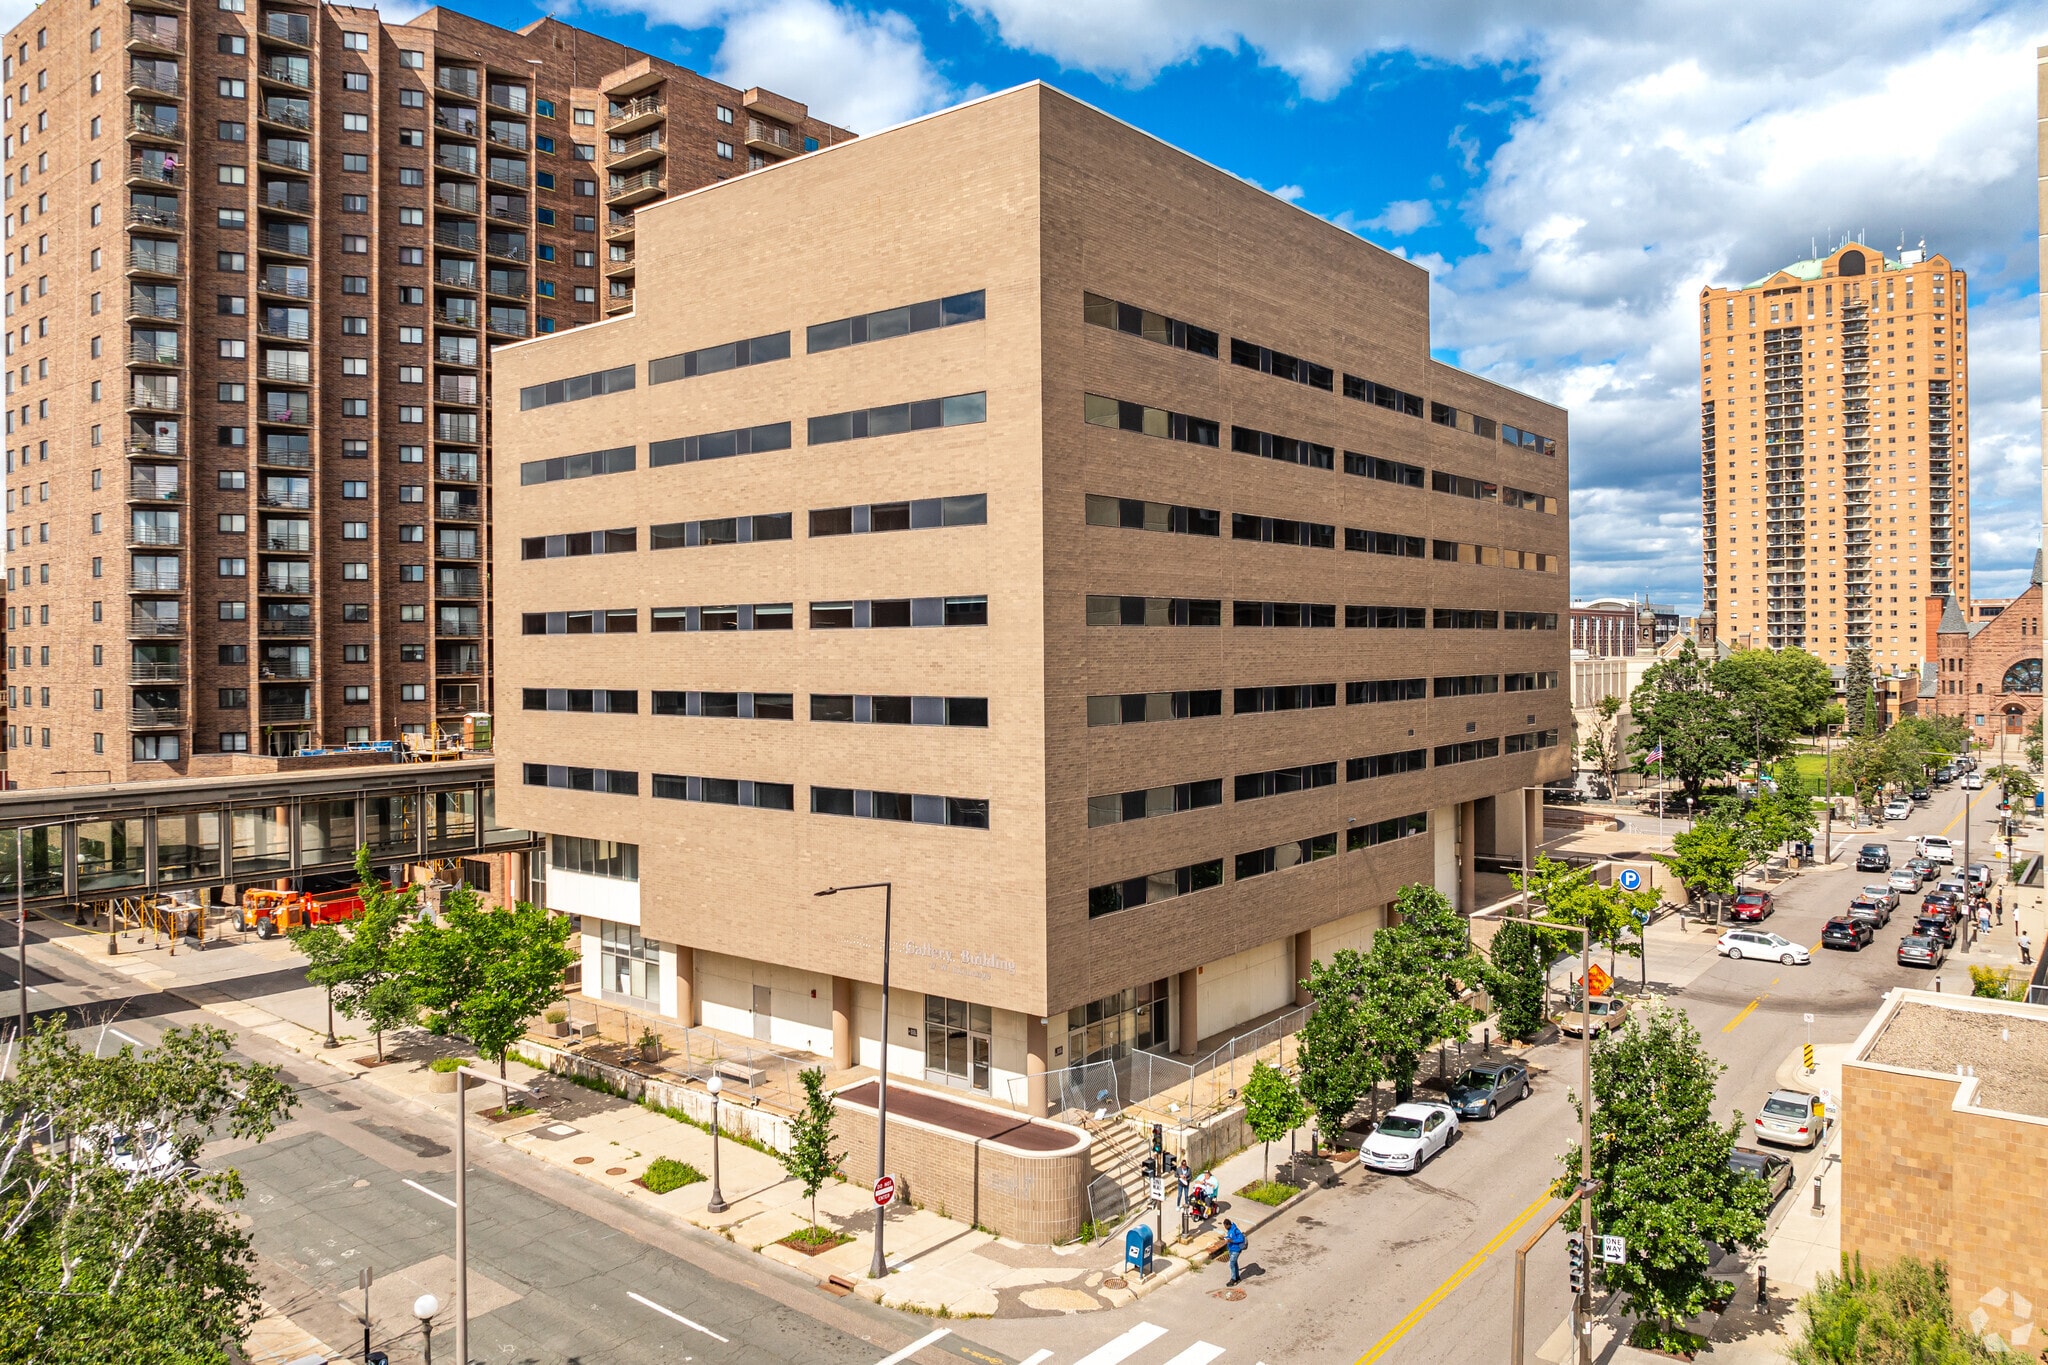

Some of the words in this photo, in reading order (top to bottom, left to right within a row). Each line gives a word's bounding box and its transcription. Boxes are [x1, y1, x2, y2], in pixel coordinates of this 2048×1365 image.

[1625, 871, 1637, 886] P
[960, 949, 1016, 976] Building
[877, 1193, 891, 1202] ENTER
[1606, 1237, 1622, 1246] ONE
[1606, 1245, 1622, 1253] WAY
